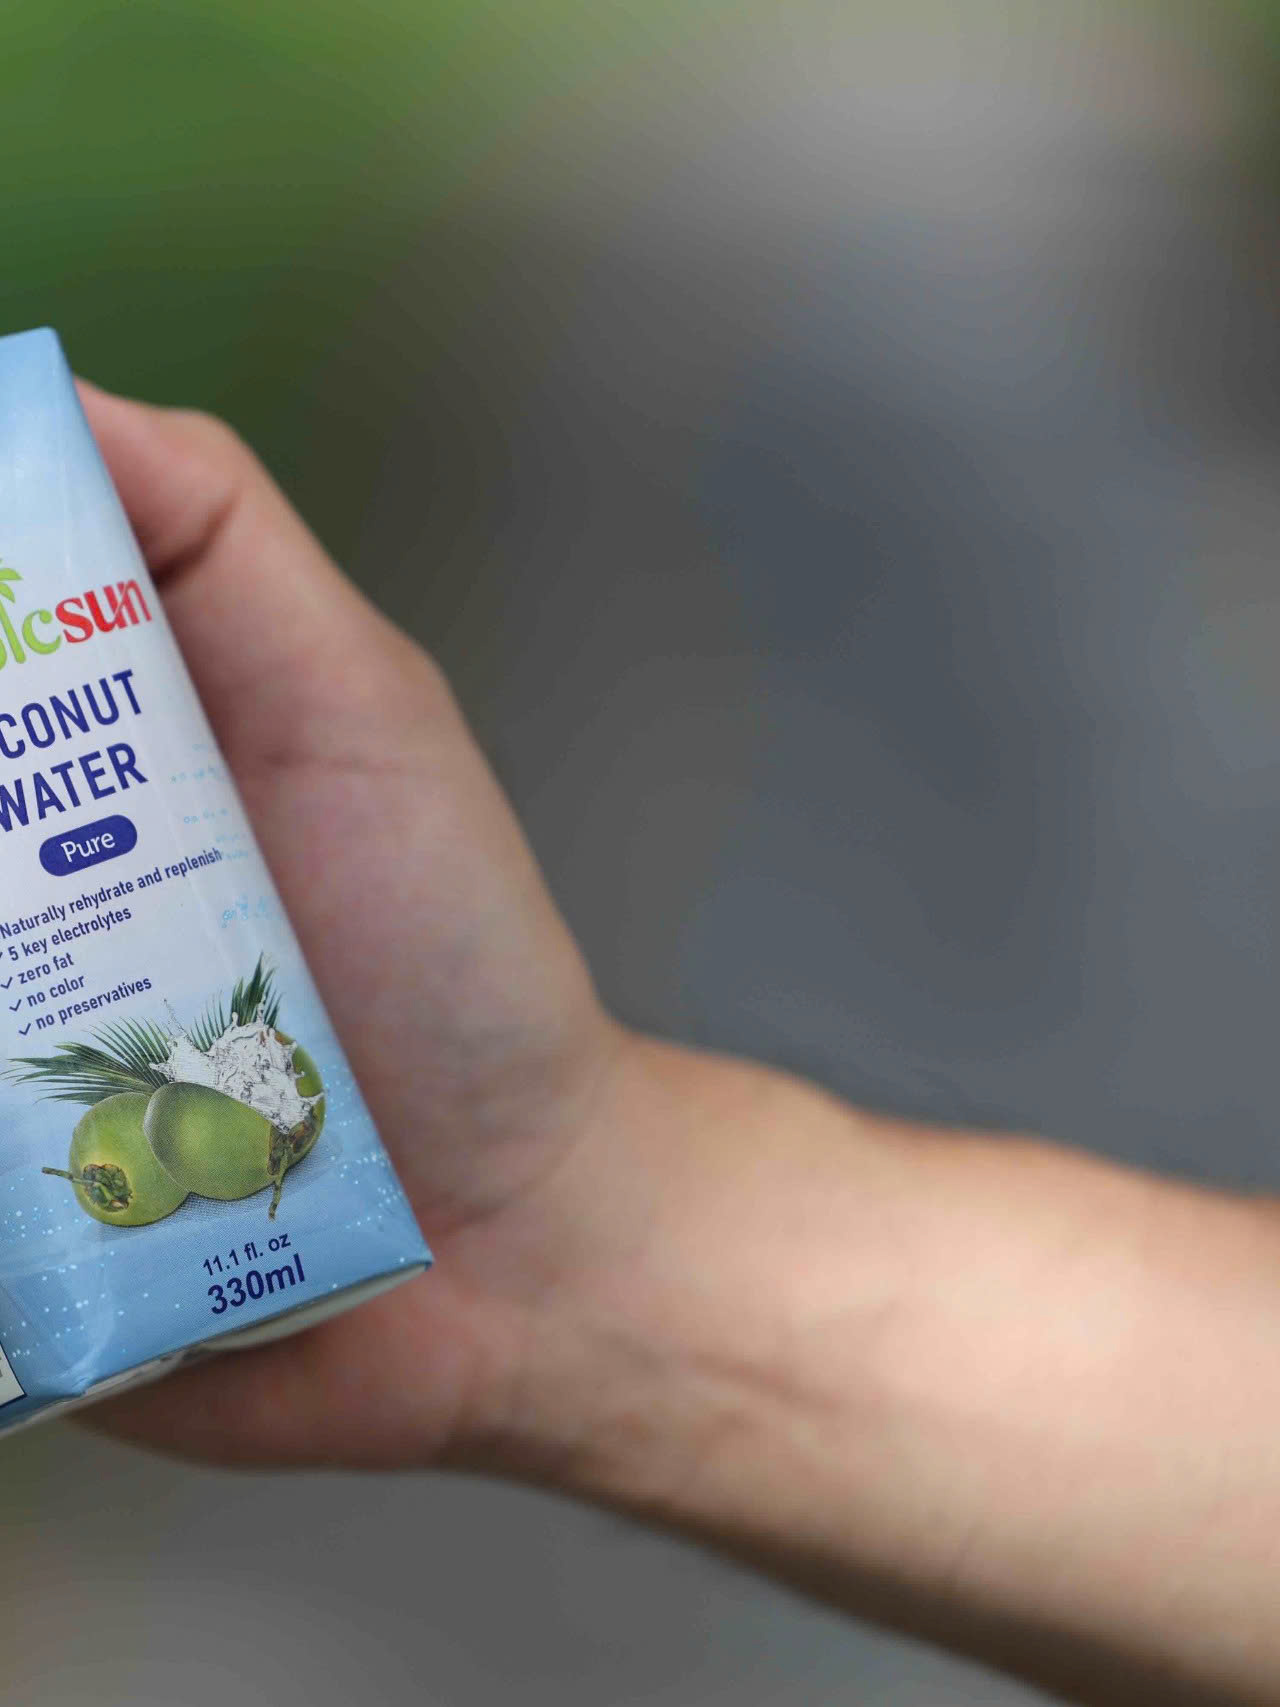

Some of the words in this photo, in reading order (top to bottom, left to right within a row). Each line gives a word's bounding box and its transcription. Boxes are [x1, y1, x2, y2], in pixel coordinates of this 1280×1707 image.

[61, 832, 116, 862] Pure
[0, 904, 66, 939] Naturally
[69, 881, 135, 914] rehydrate
[137, 868, 163, 890] and
[165, 847, 223, 878] replenish
[8, 946, 19, 961] 5
[22, 938, 48, 956] key
[51, 906, 132, 946] electrolytes
[18, 964, 51, 985] zero
[53, 952, 74, 972] fat
[26, 991, 46, 1007] no
[49, 974, 86, 999] color
[36, 1014, 55, 1030] no
[58, 975, 152, 1025] preservatives
[203, 1249, 240, 1276] 11.1
[244, 1241, 264, 1261] fl.
[268, 1233, 291, 1251] oz
[207, 1252, 306, 1315] 330ml
